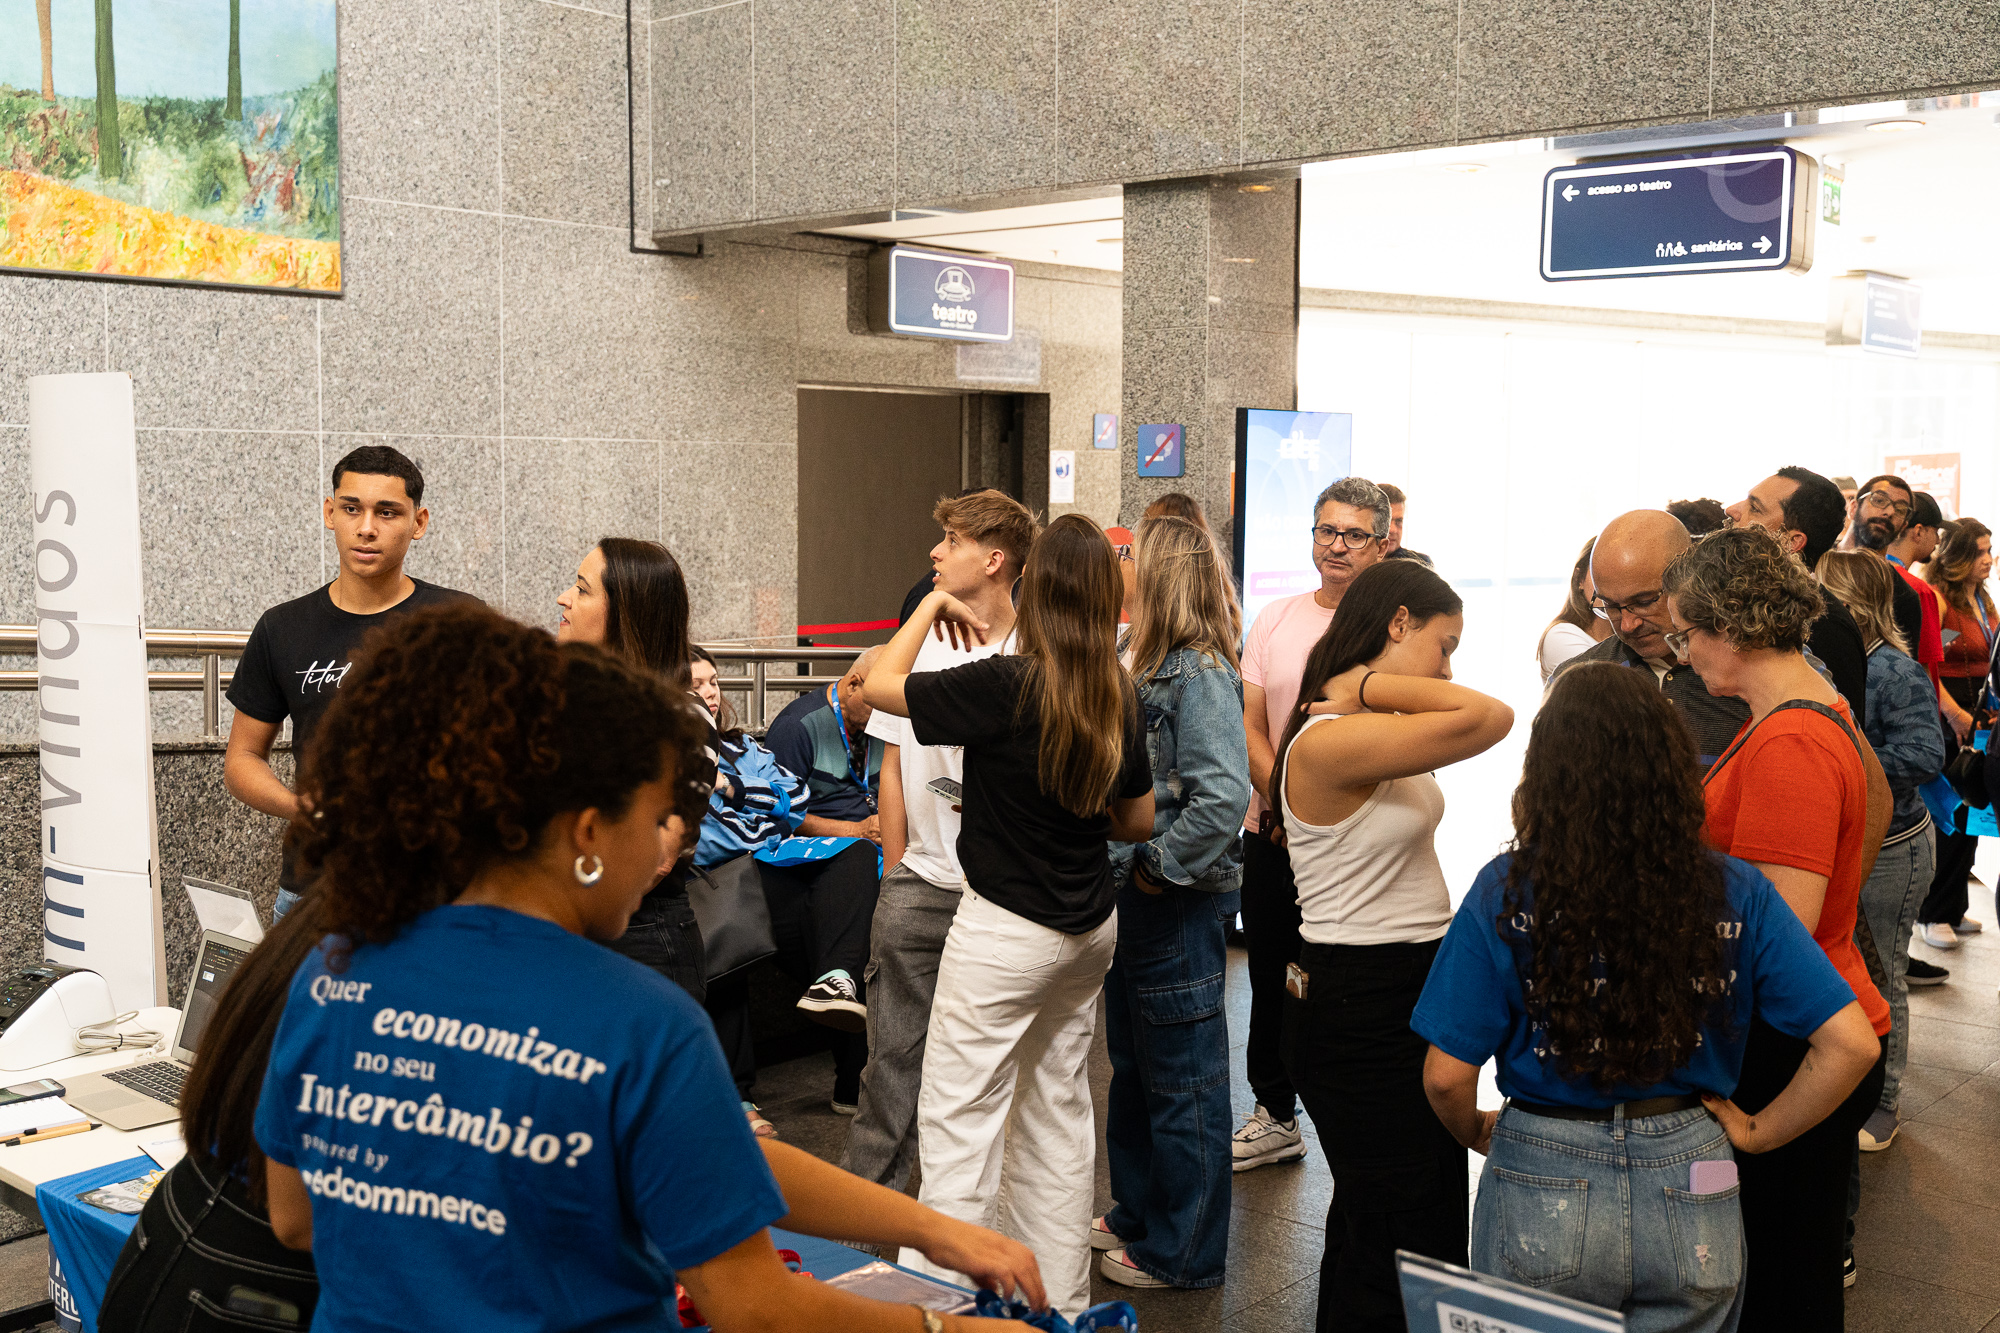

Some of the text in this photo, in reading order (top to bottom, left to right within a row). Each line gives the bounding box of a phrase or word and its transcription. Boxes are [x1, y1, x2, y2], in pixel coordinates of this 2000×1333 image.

[1587, 179, 1672, 196] acesso ao teatro
[1691, 239, 1743, 255] sanitários
[931, 302, 978, 324] teatro
[34, 489, 85, 963] m-vindos
[310, 974, 372, 1006] Quer
[372, 1007, 607, 1085] economizar
[354, 1050, 436, 1082] no seu
[297, 1072, 593, 1168] Intercâmbio?
[364, 1147, 389, 1173] by
